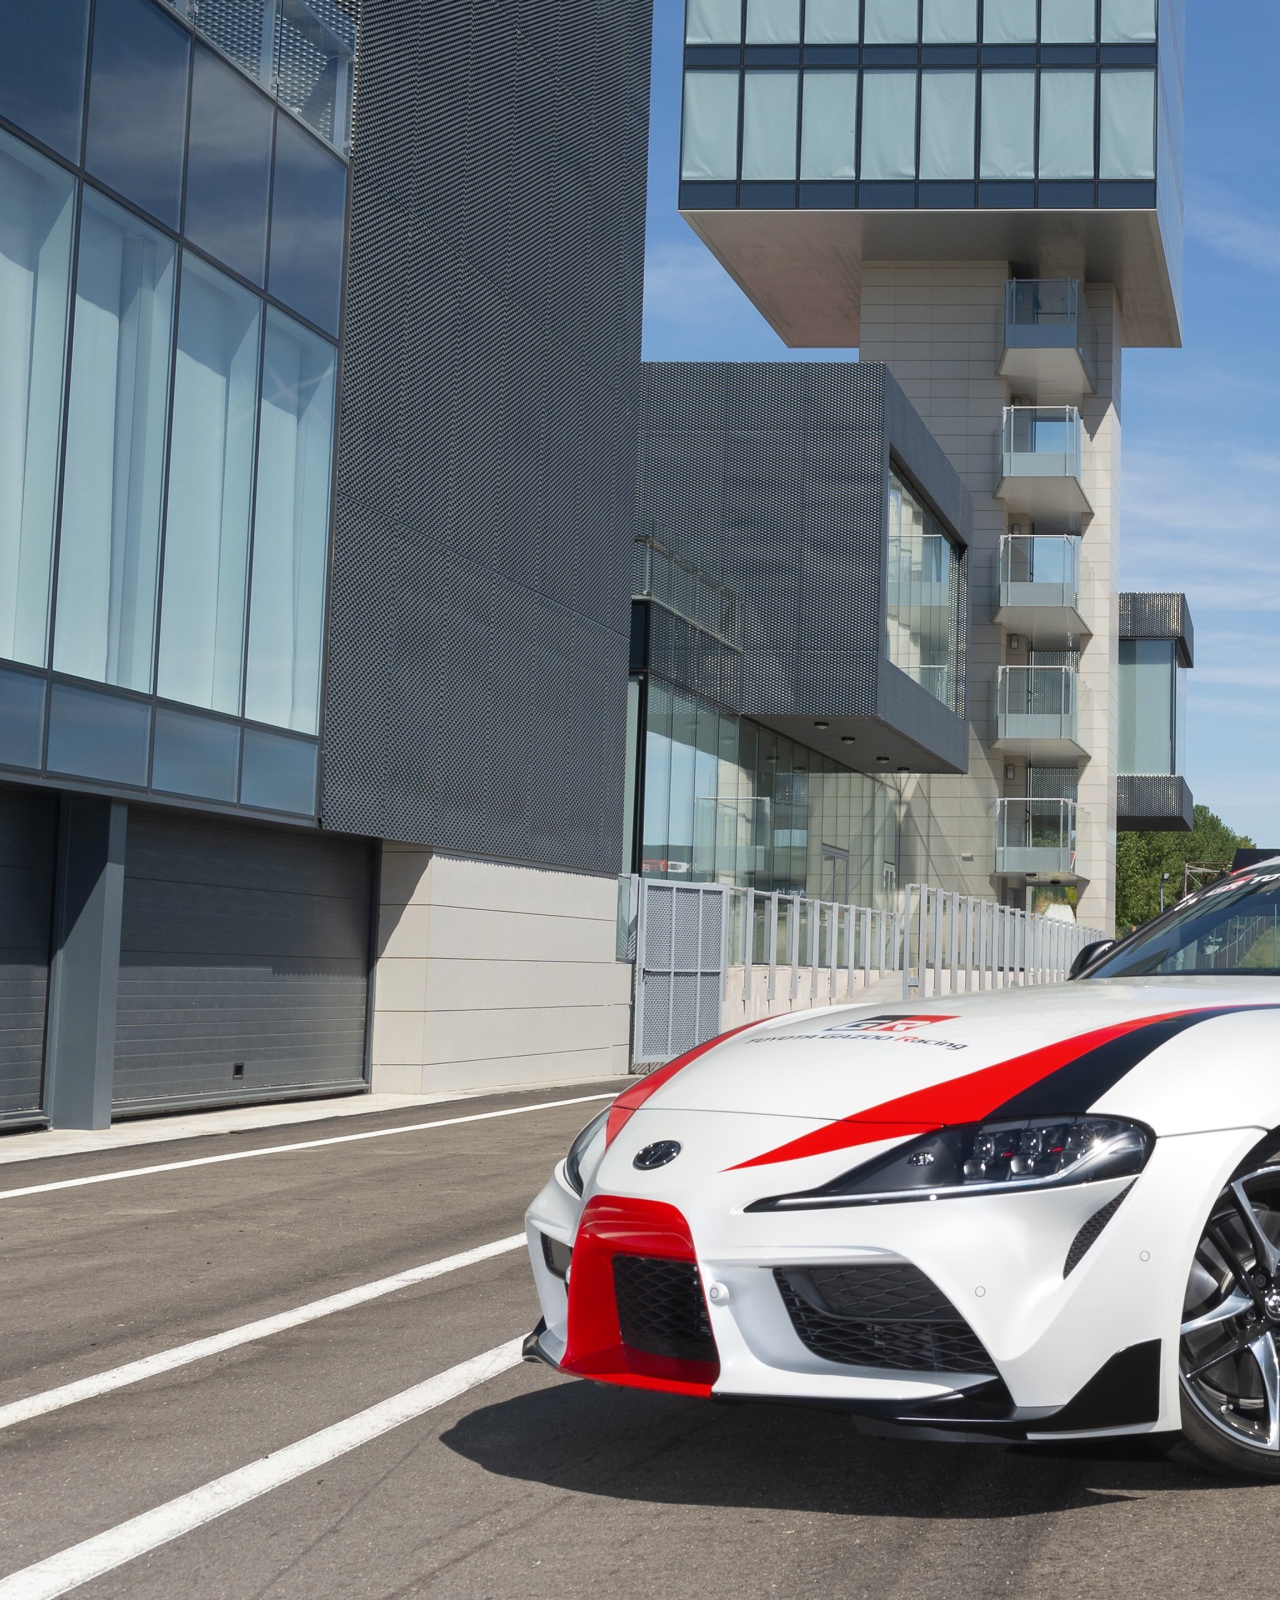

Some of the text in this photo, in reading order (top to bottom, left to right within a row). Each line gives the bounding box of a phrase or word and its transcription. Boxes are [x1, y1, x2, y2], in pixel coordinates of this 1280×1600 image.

[828, 1018, 932, 1032] GR
[819, 1033, 894, 1041] GAZOO
[895, 1036, 968, 1050] Racing
